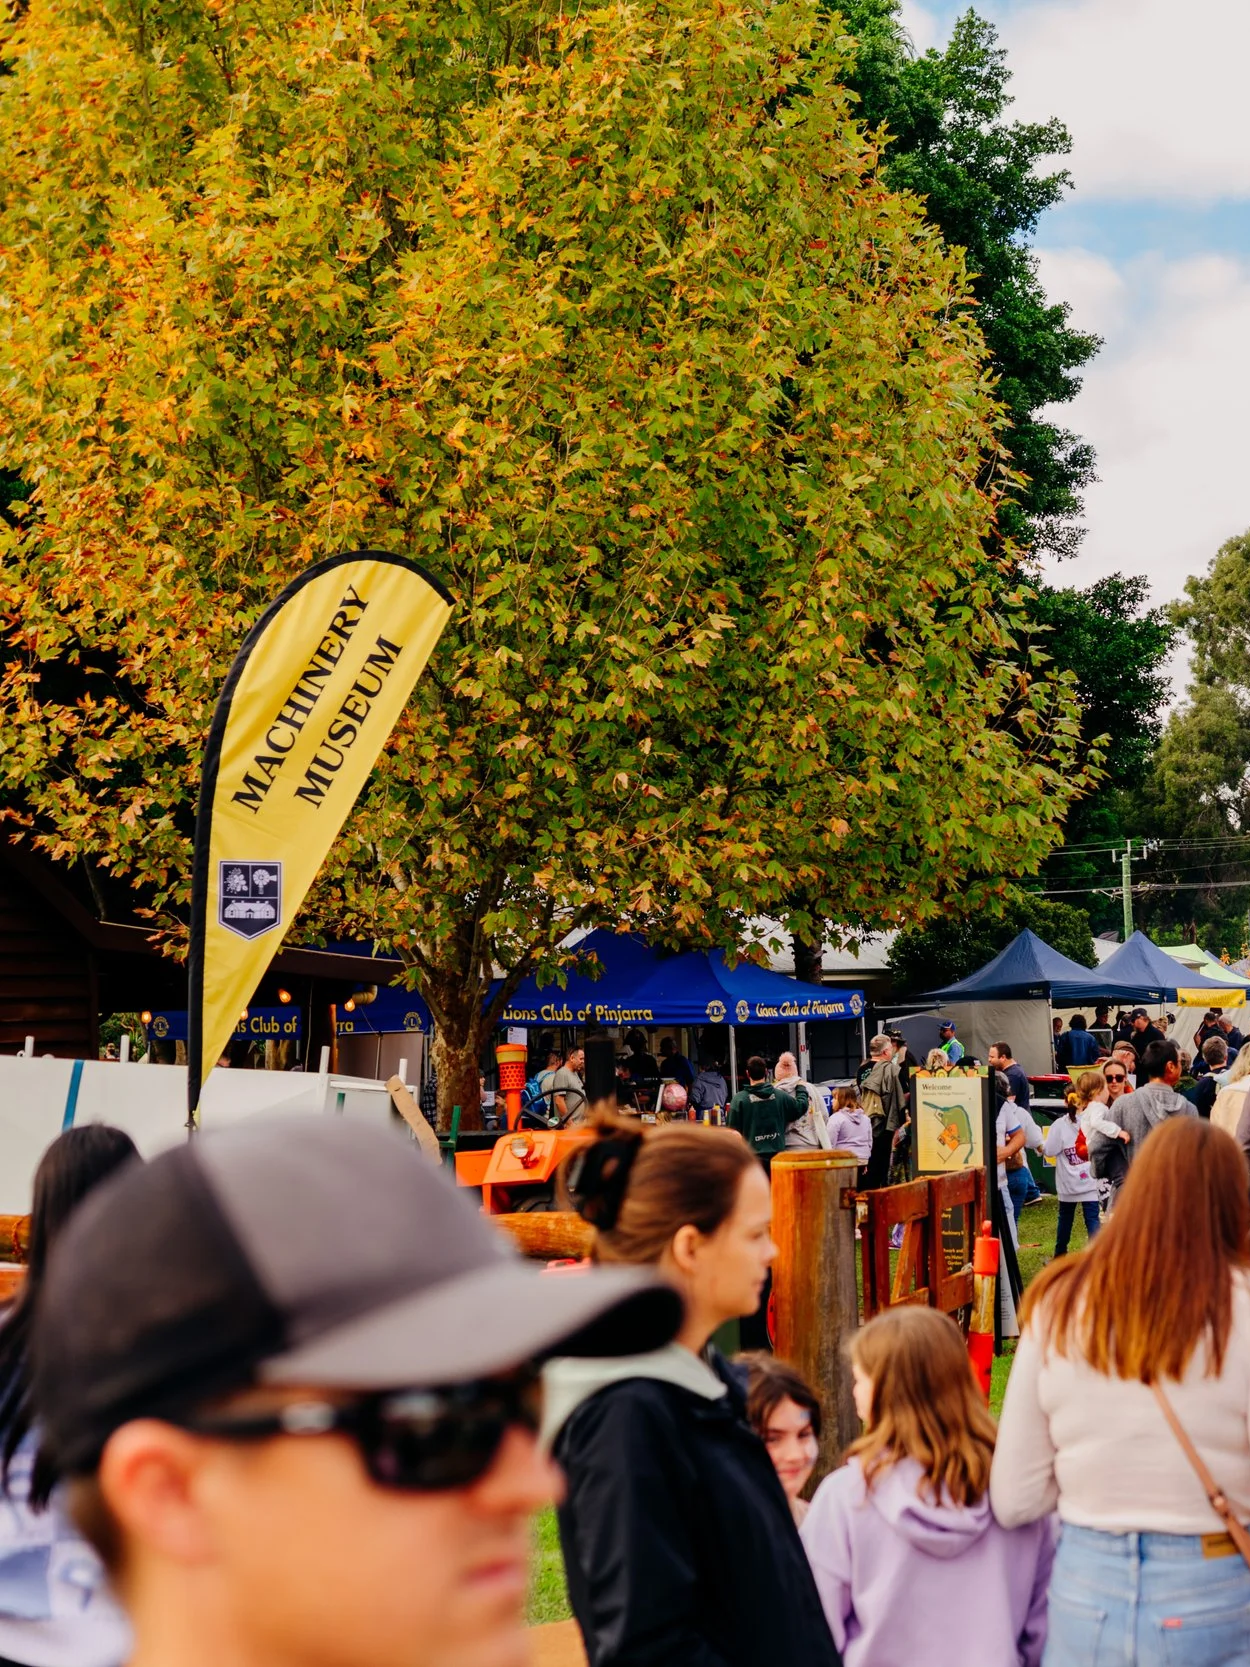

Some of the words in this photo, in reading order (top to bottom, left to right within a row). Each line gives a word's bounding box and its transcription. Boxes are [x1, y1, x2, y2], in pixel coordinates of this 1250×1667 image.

[230, 584, 370, 815] MACHINERY
[294, 634, 404, 810] MUSEUM
[502, 1004, 537, 1021] Lions
[541, 1003, 573, 1021] Club
[595, 1004, 653, 1025] Pinjarra
[756, 1003, 778, 1017] Lions
[779, 1001, 799, 1017] Club
[812, 1000, 845, 1018] Pinjarra
[250, 1016, 280, 1033] Club
[283, 1015, 297, 1033] of
